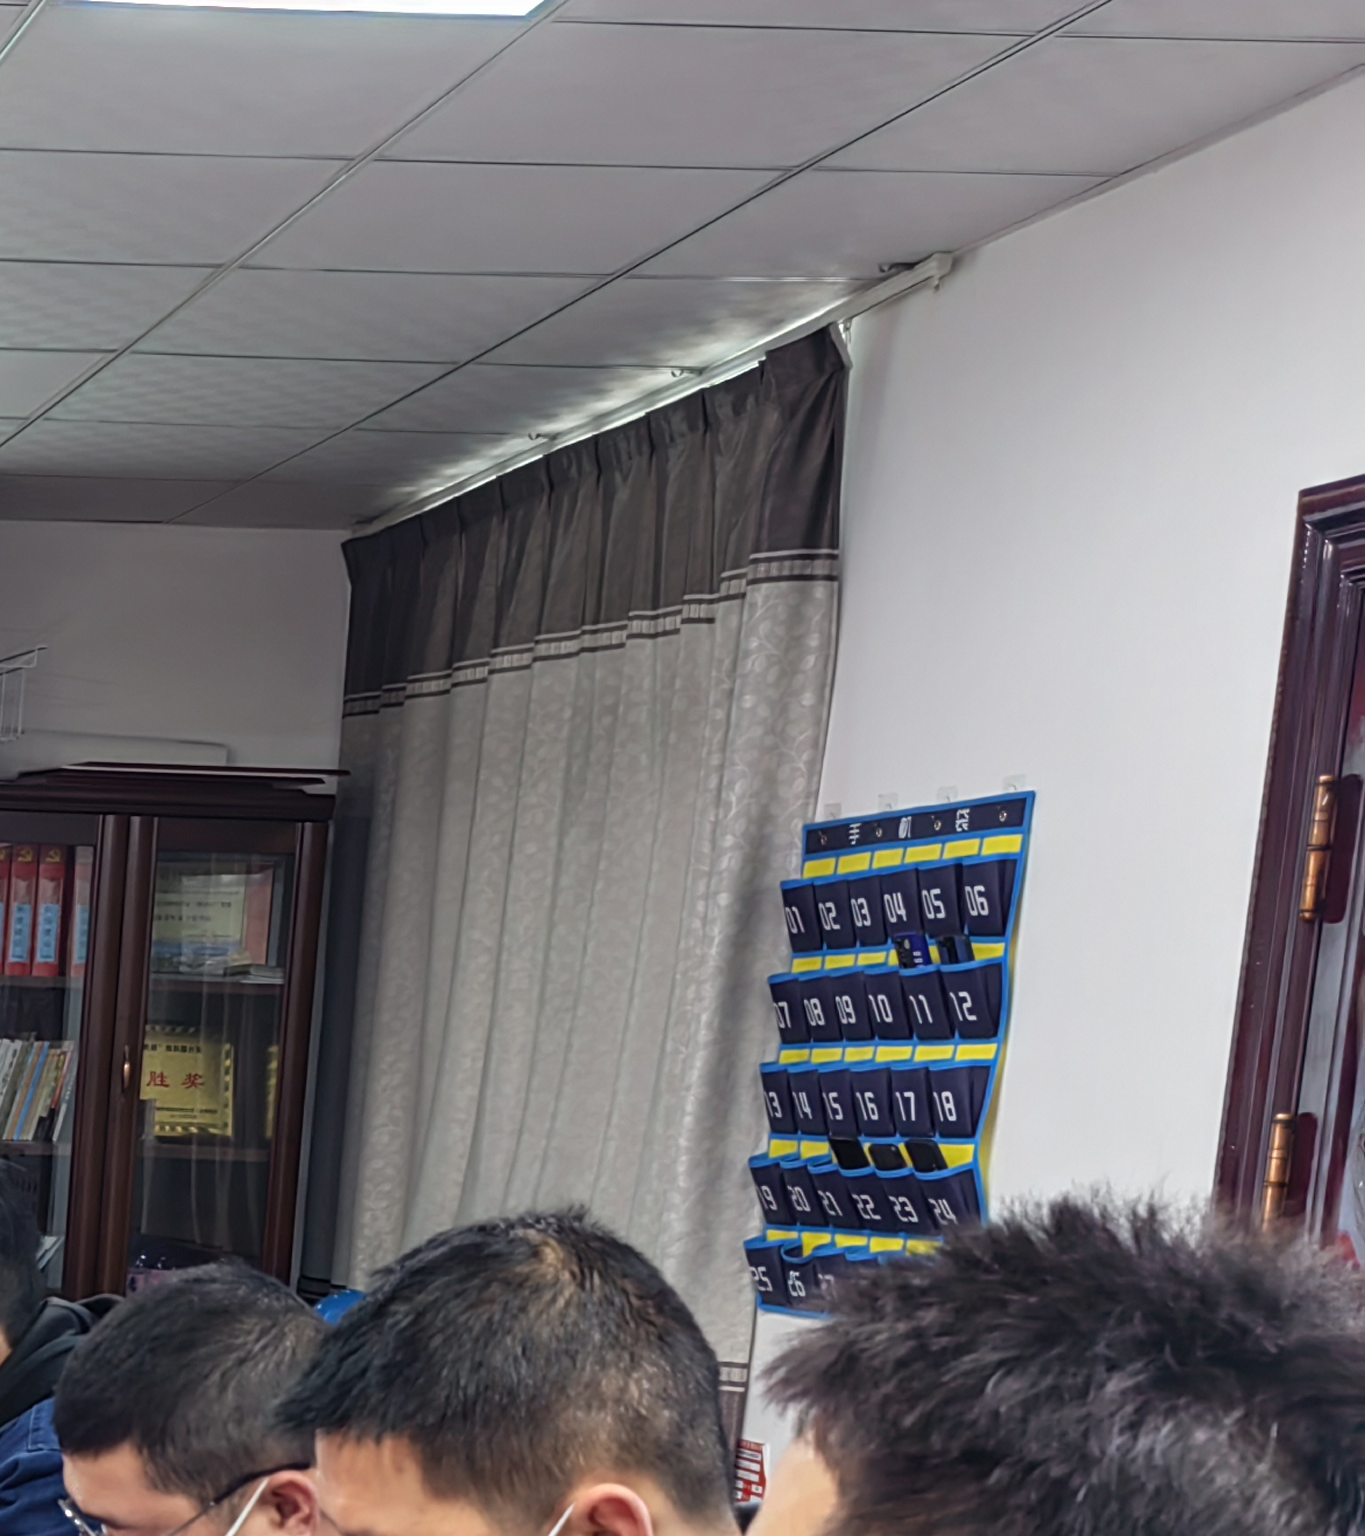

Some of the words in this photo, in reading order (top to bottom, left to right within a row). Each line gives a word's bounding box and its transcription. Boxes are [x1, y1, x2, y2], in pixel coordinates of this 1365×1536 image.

[785, 904, 806, 934] 01
[818, 902, 840, 931] 02
[850, 898, 871, 927] 03
[883, 892, 907, 923] 04
[922, 889, 946, 919] 05
[965, 885, 989, 916] 06
[773, 1001, 792, 1028] 07
[803, 998, 825, 1025] 08
[835, 995, 856, 1024] 09
[868, 994, 893, 1023] 10
[909, 994, 933, 1024] 11
[949, 991, 977, 1021] 12
[792, 1091, 813, 1119] 14
[822, 1092, 843, 1121] 15
[855, 1092, 879, 1121] 16
[895, 1091, 916, 1121] 17
[933, 1091, 957, 1121] 18
[787, 1185, 811, 1212] 20
[817, 1190, 843, 1217] 21
[852, 1194, 881, 1220] 22
[889, 1195, 919, 1222] 23
[929, 1198, 958, 1226] 24
[750, 1266, 773, 1292] 25
